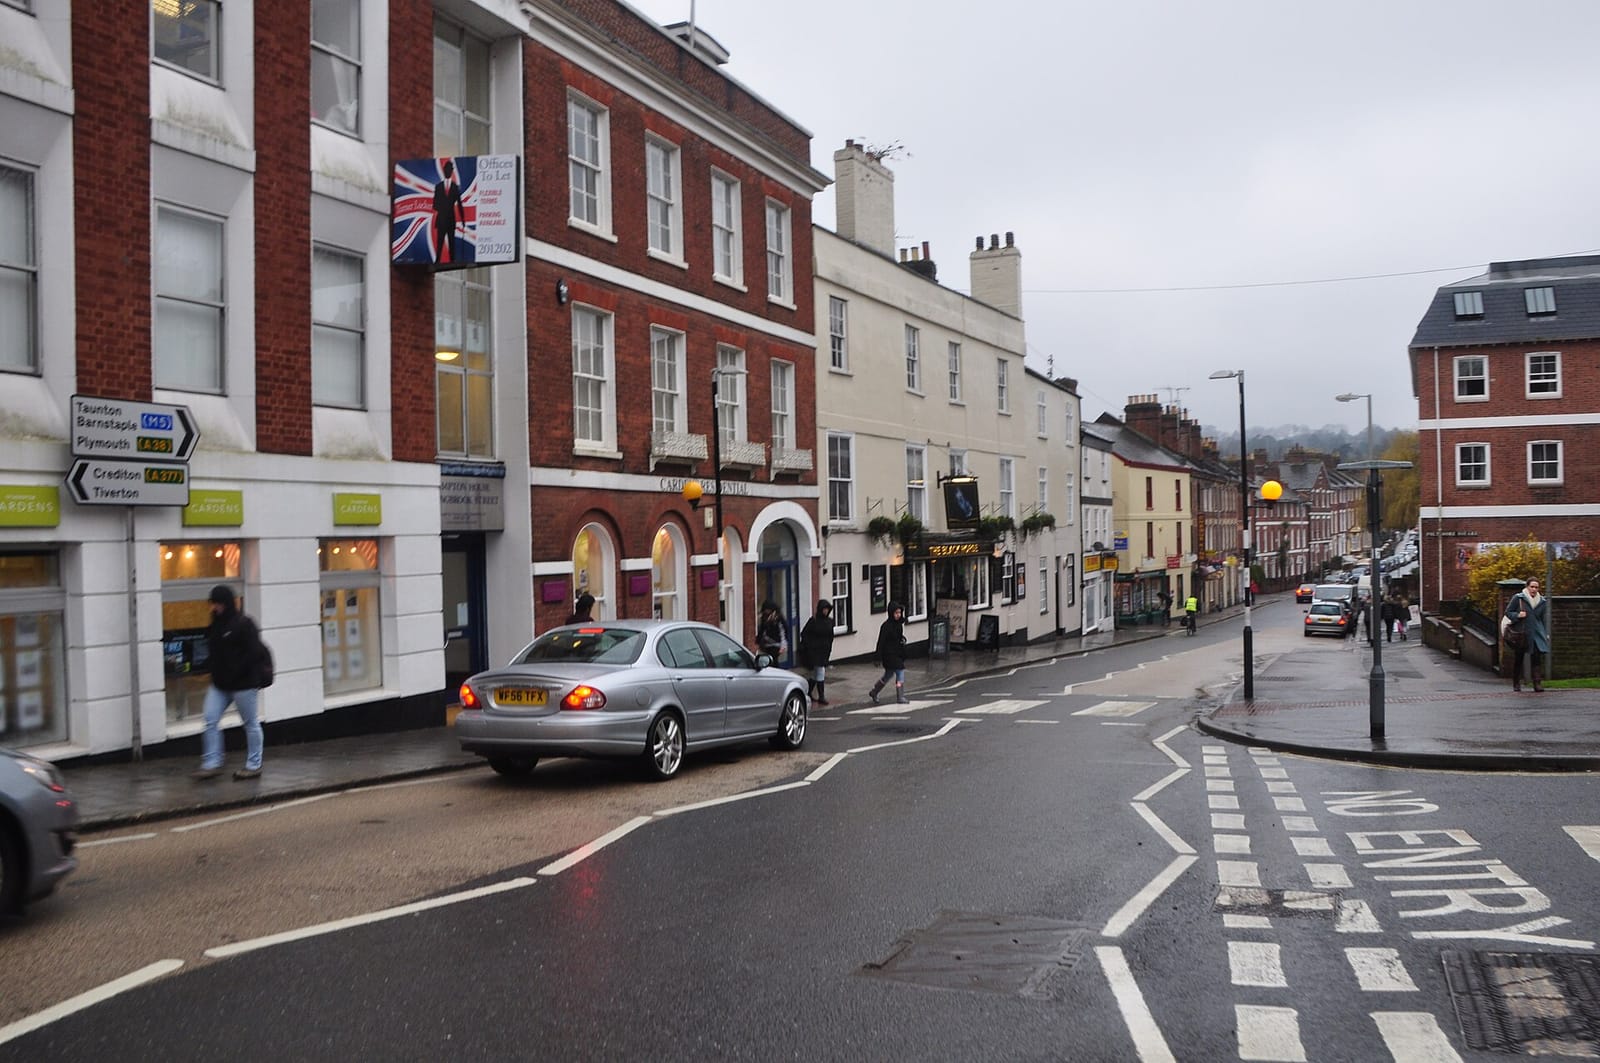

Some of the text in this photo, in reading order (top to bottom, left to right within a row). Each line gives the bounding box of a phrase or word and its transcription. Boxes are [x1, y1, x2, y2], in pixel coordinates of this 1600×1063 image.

[478, 157, 513, 170] Offices
[480, 169, 511, 182] To Let
[76, 401, 122, 416] Taunton
[76, 416, 138, 431] Barnstaple
[77, 436, 130, 450] Plymouth
[93, 468, 184, 483] Crediton (A377)
[93, 487, 139, 498] Tiverton
[526, 690, 543, 702] TFX
[1319, 789, 1440, 817] NO
[1346, 828, 1597, 950] ENTRY
